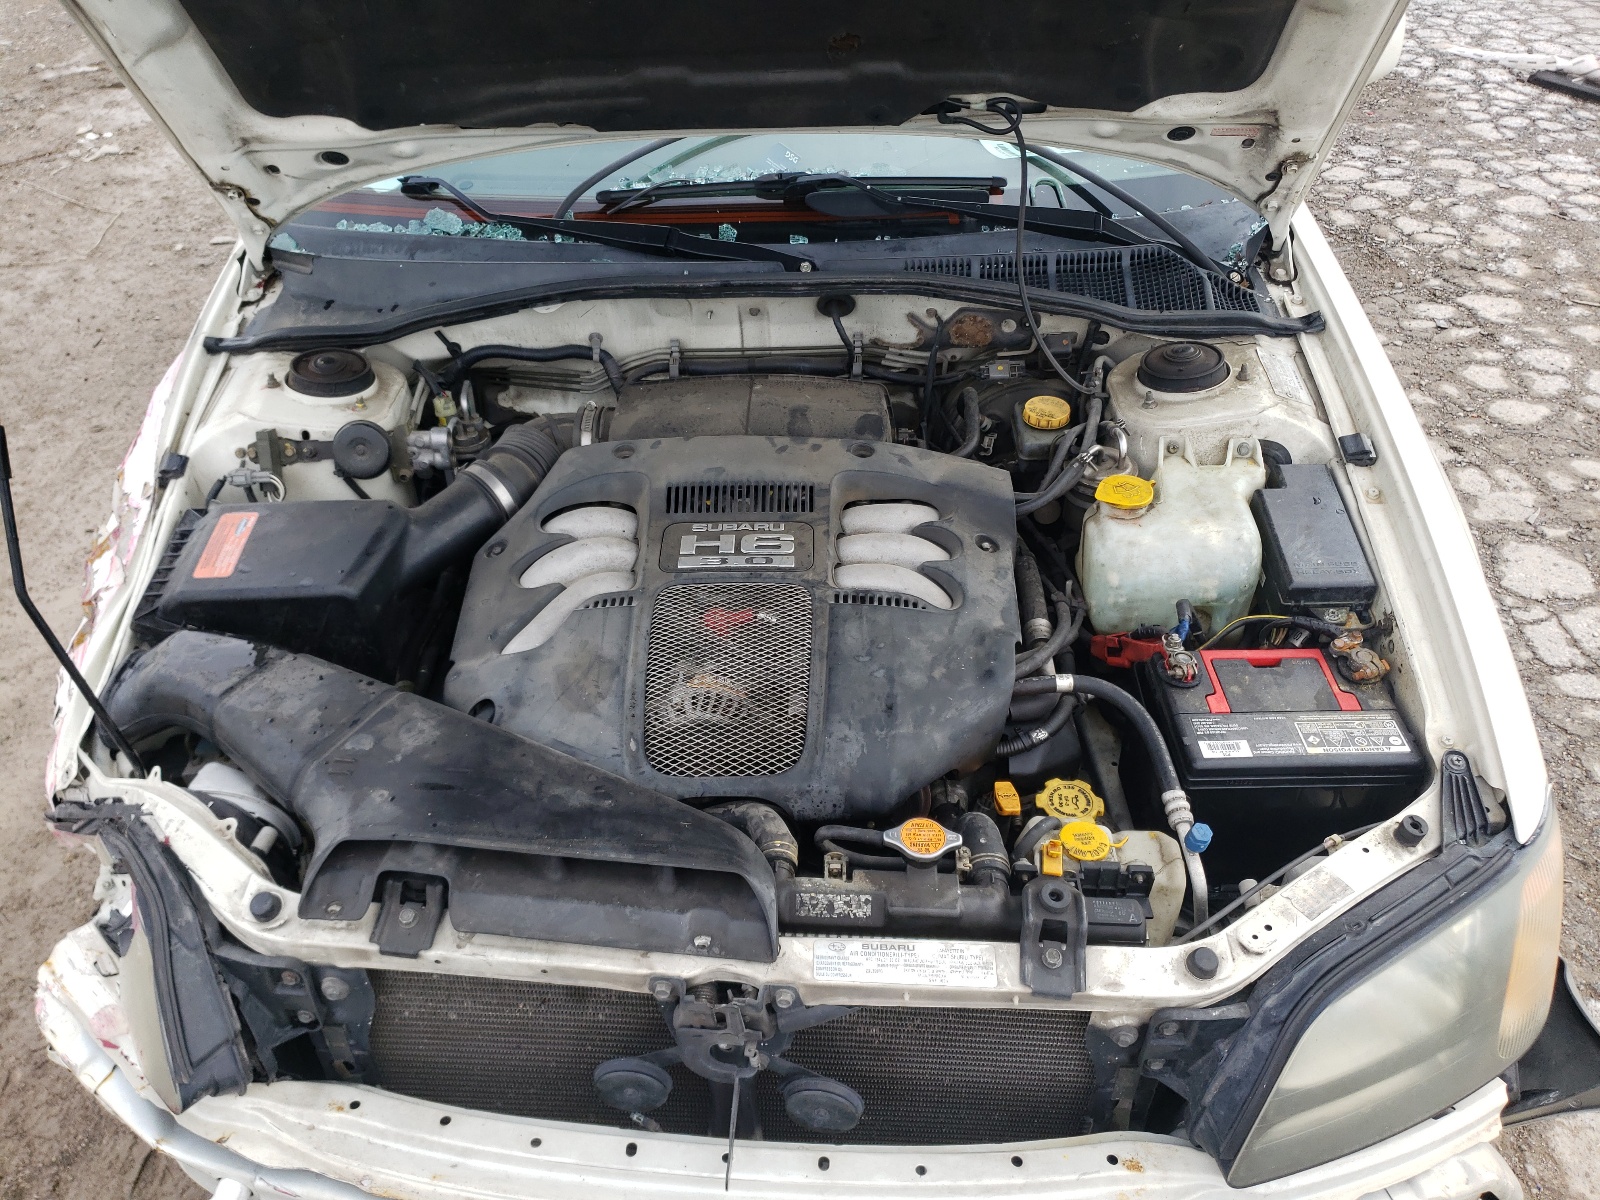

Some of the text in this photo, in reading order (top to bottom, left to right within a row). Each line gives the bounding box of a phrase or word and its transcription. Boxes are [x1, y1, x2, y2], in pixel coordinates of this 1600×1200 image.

[692, 523, 785, 532] SUBARU
[680, 534, 795, 555] H6
[700, 556, 774, 565] 3.0
[861, 943, 916, 951] SUBARU
